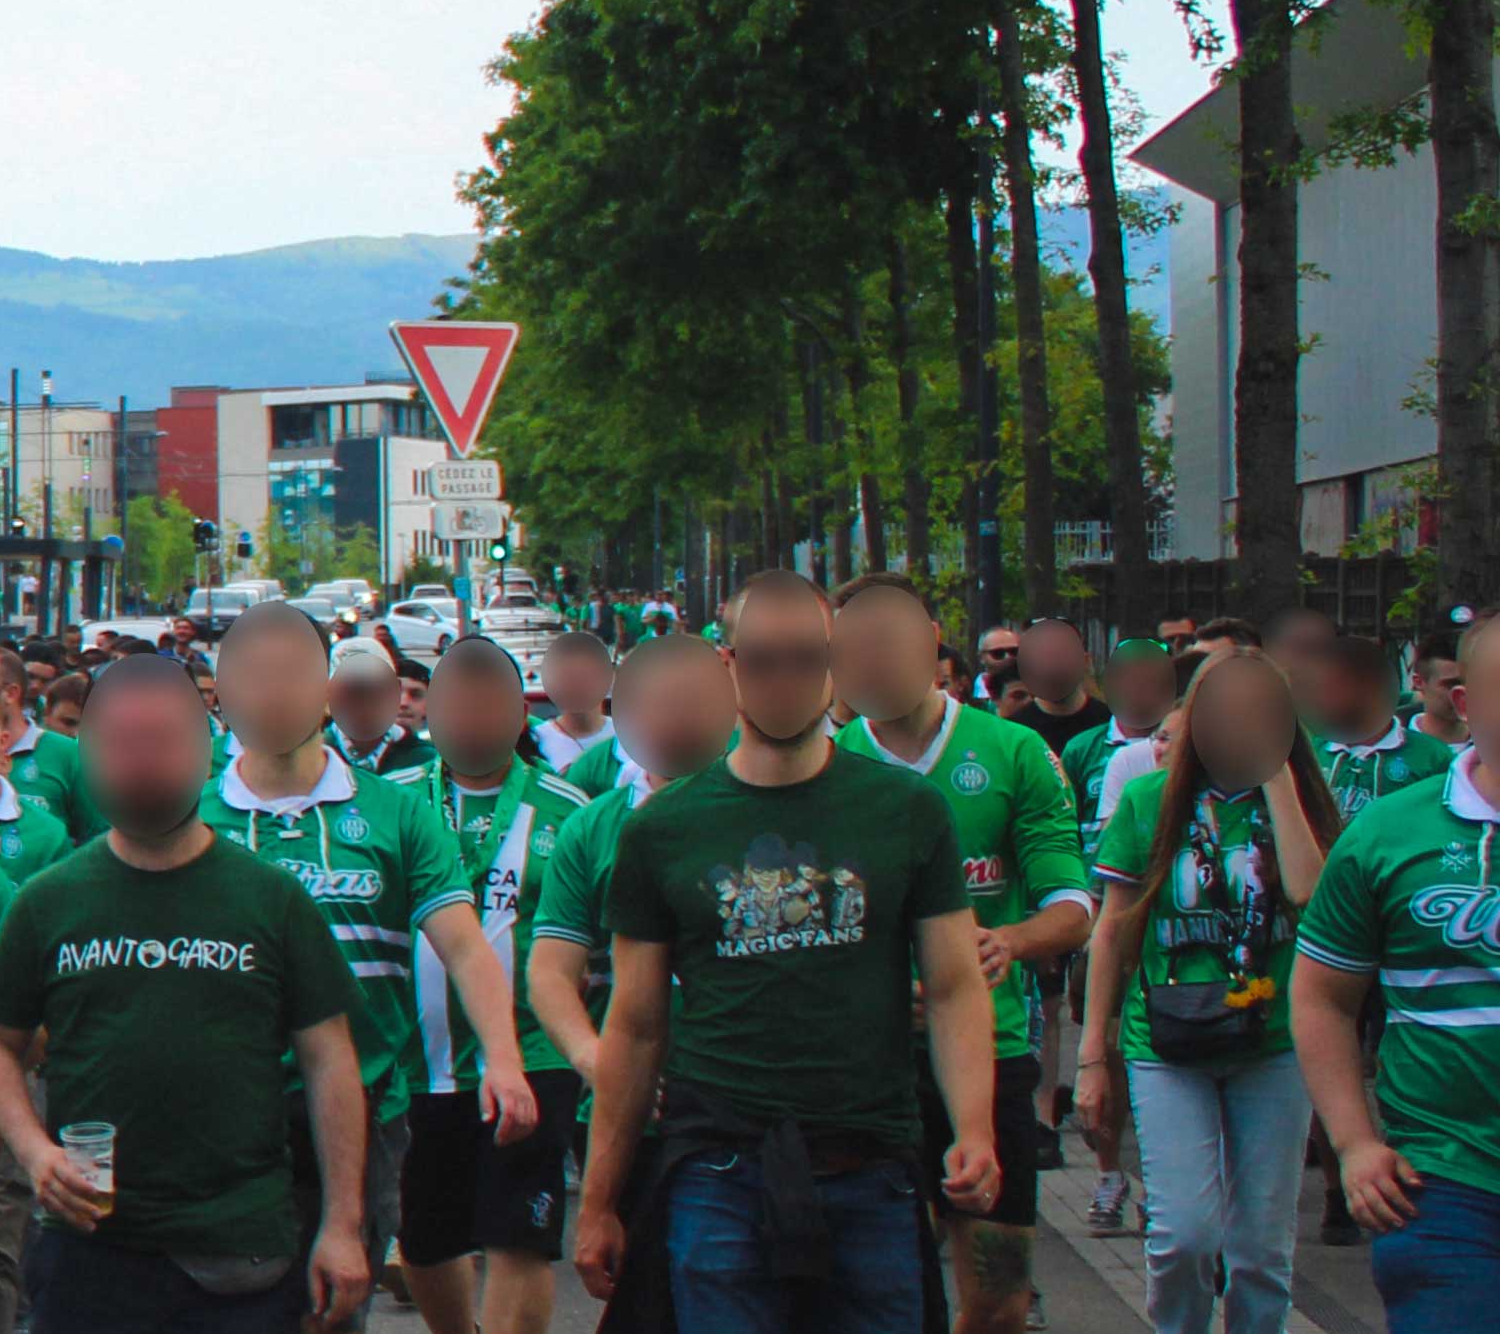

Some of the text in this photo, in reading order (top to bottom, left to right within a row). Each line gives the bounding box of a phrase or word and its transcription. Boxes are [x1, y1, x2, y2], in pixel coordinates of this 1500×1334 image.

[480, 467, 493, 479] LE
[441, 482, 493, 493] PASSAGE
[716, 926, 864, 957] MAGIC FANS
